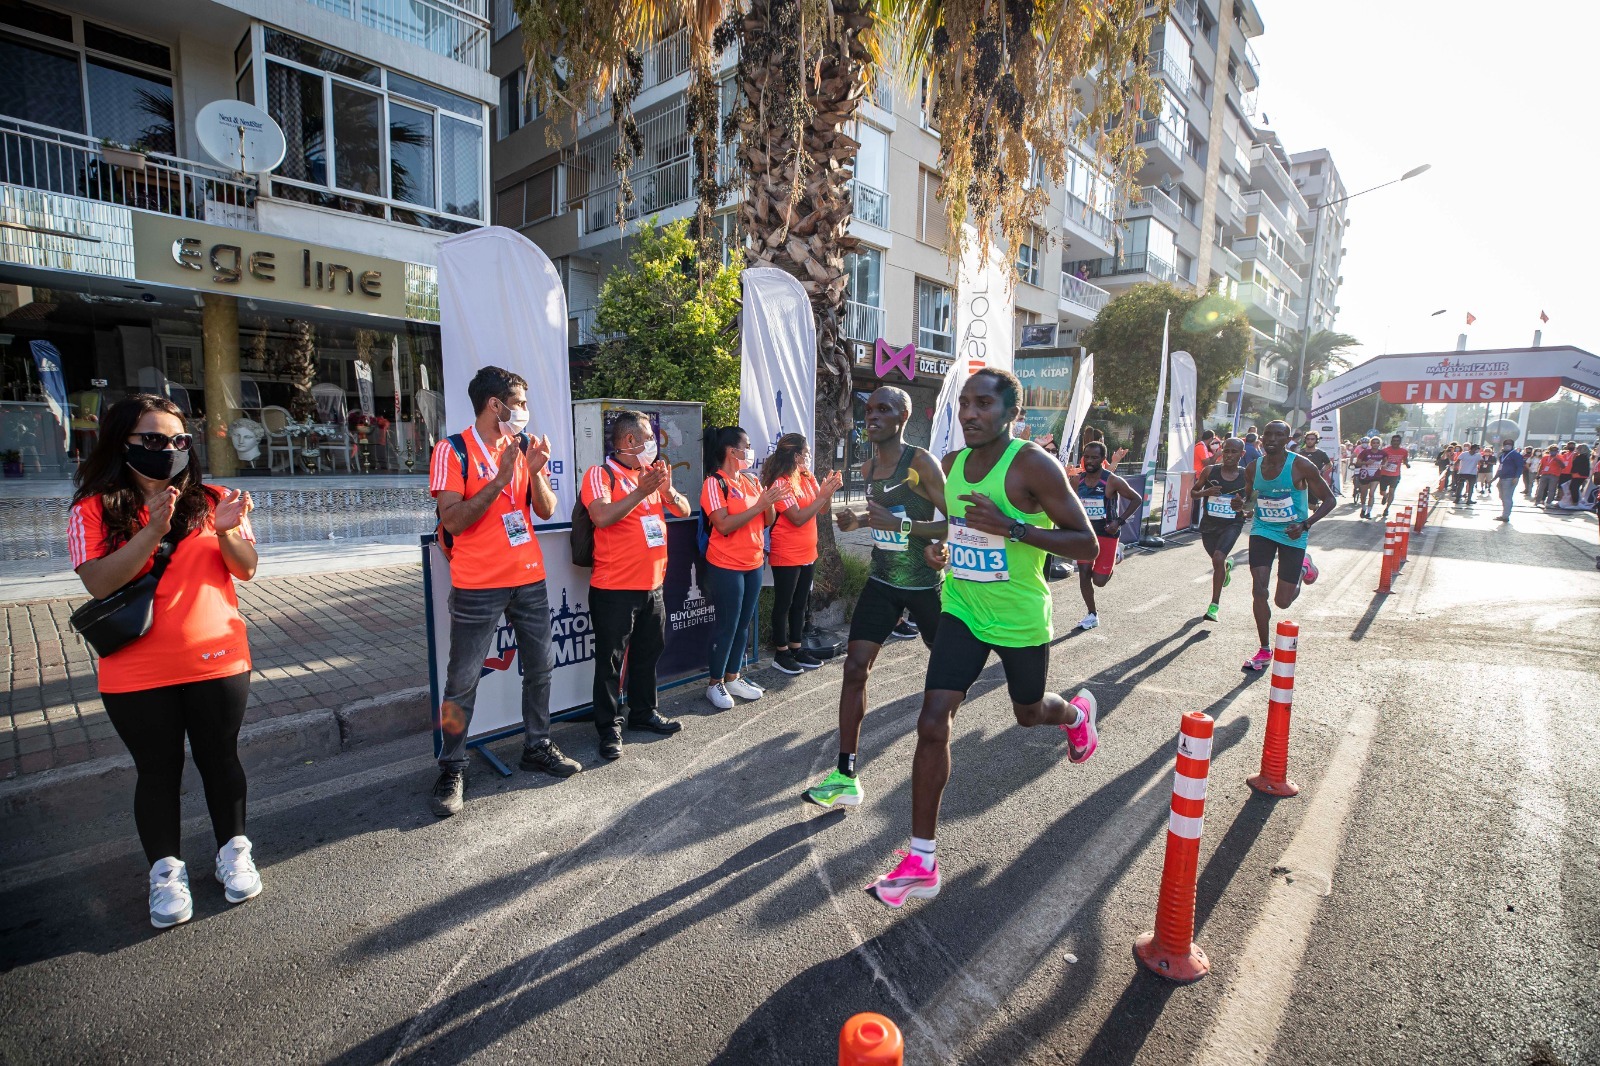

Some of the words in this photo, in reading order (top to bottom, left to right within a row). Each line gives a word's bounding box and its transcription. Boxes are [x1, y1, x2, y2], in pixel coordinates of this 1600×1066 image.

[219, 113, 232, 123] Next
[233, 116, 239, 124] &
[240, 118, 262, 129] NextStar
[1041, 366, 1068, 378] KİTAP
[1406, 380, 1525, 400] FINISH
[1311, 387, 1373, 417] maratonizmir.org
[1087, 507, 1105, 516] 020
[1260, 507, 1294, 518] 10361
[949, 545, 1005, 570] 10013
